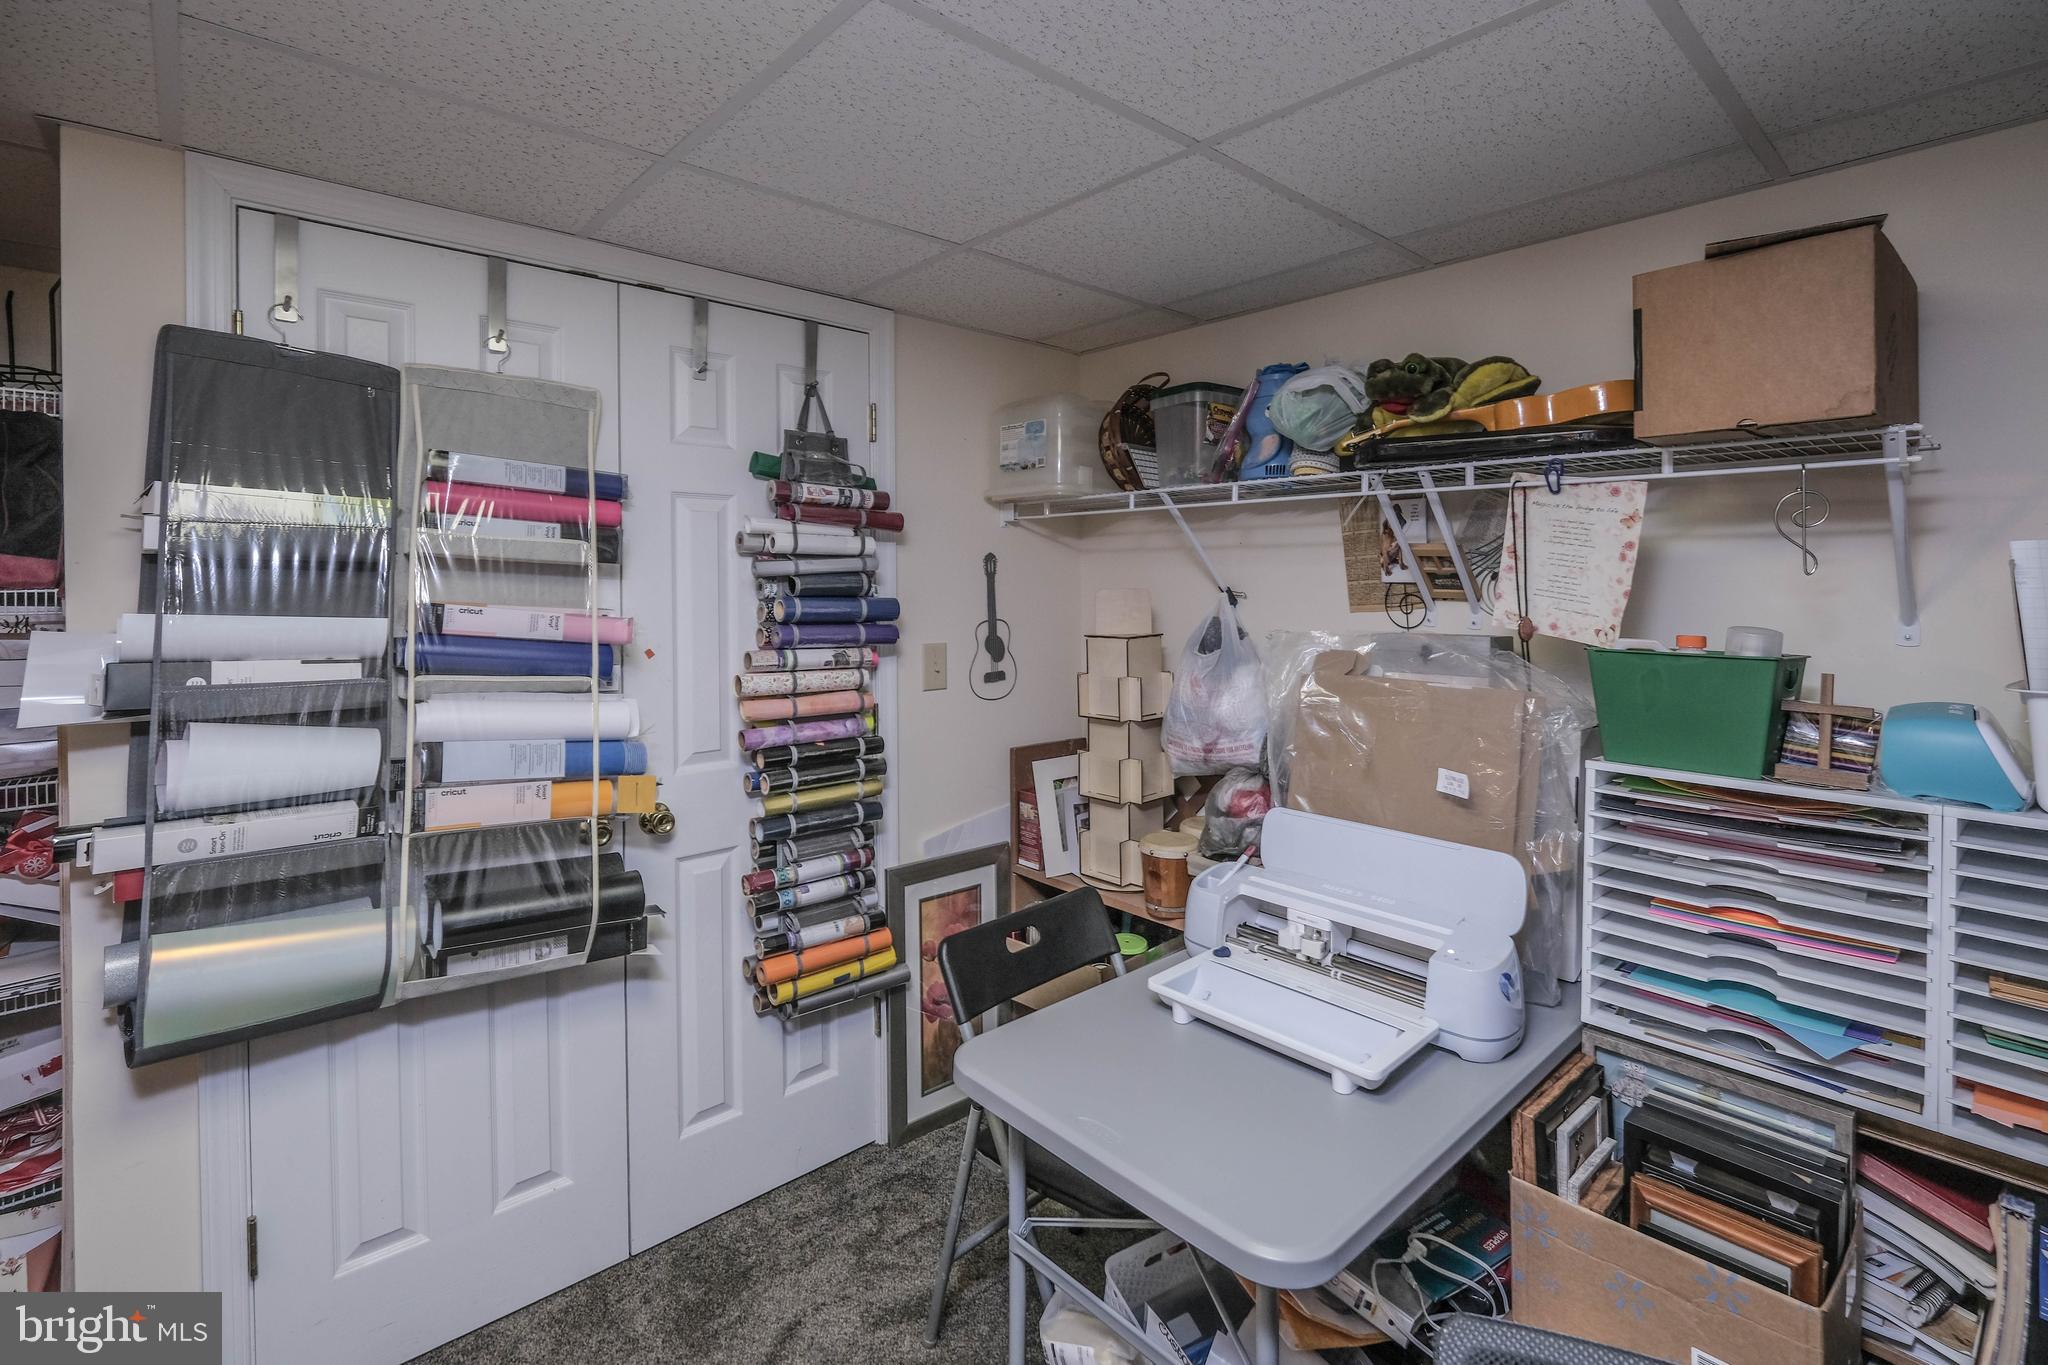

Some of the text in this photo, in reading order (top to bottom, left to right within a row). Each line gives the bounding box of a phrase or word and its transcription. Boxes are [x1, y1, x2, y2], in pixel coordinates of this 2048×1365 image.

[458, 607, 484, 616] cricut
[441, 788, 467, 797] cricut
[313, 831, 342, 841] cricut
[209, 836, 217, 855] Smart
[1483, 1229, 1509, 1251] STAPLES
